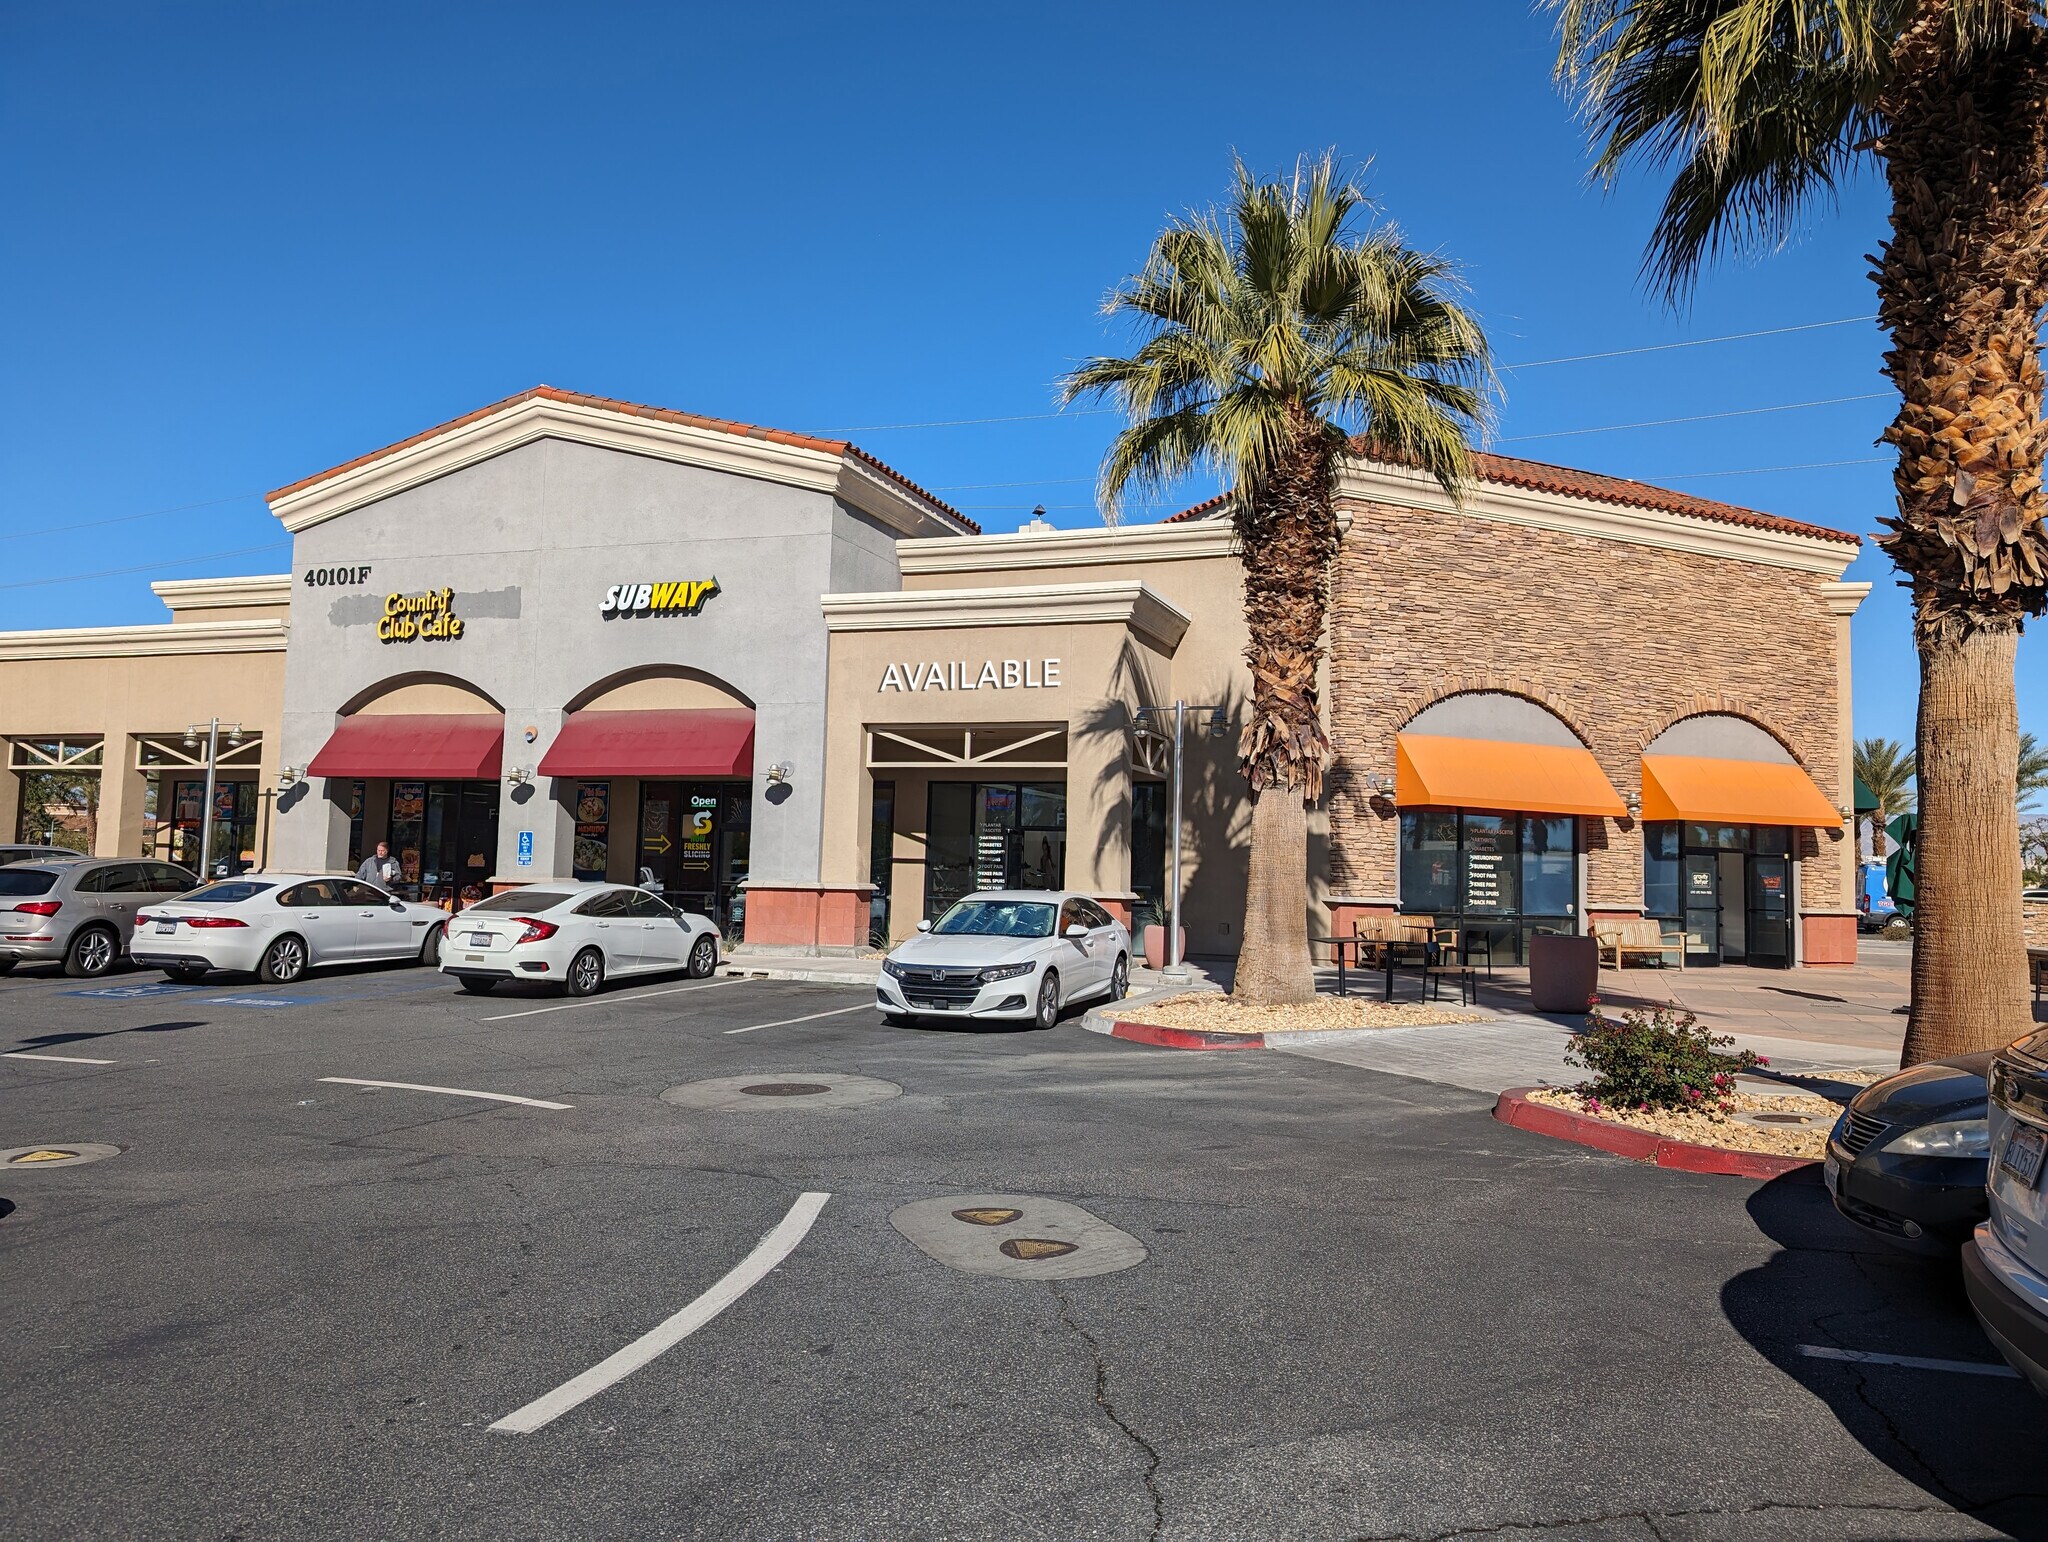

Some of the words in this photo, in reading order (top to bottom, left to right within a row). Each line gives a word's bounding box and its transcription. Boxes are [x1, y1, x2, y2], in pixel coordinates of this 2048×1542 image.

[304, 566, 372, 587] 40101F
[384, 587, 451, 616] Country
[598, 579, 715, 611] SUBWAY
[376, 615, 416, 640] Club
[418, 613, 461, 637] Cafe
[879, 658, 1062, 692] AVAILABLE
[691, 796, 716, 808] Open
[683, 850, 711, 858] SLICING
[684, 843, 712, 851] FRESHLY
